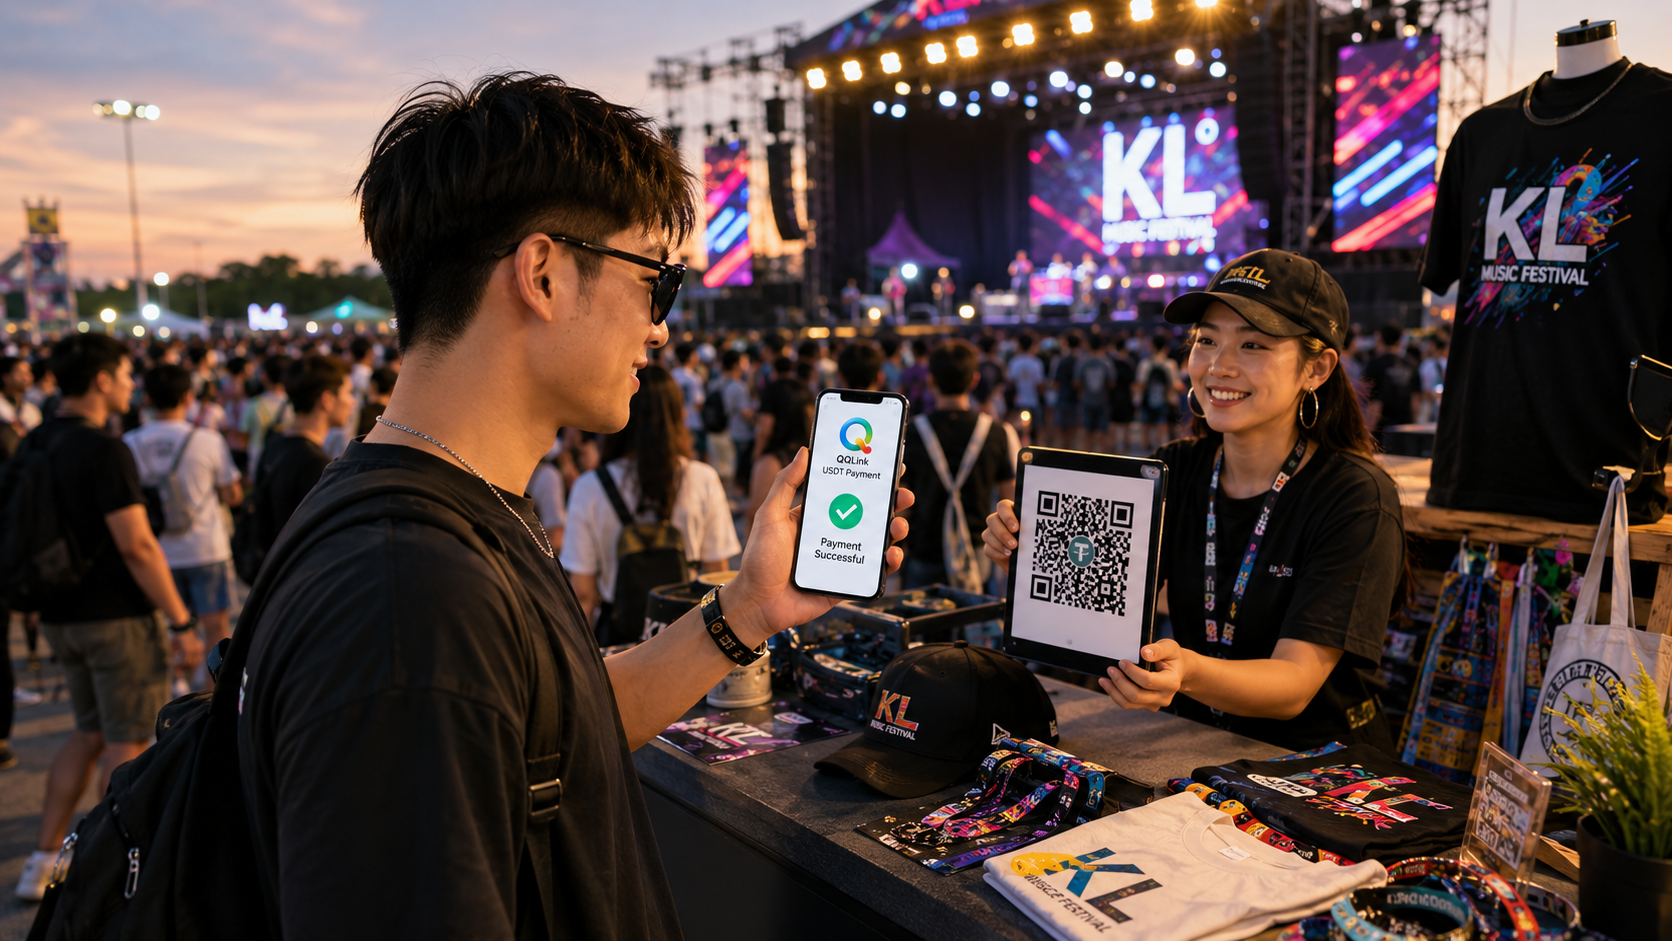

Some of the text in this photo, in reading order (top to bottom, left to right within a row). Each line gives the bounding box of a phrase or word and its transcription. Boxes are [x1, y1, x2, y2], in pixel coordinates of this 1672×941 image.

[1484, 187, 1587, 262] KL
[1481, 265, 1589, 286] MUSIC FESTIVAL
[836, 454, 869, 466] QQLink
[822, 466, 881, 479] USDT Payment
[820, 537, 862, 551] Payment
[814, 549, 865, 564] Successful
[874, 689, 919, 731] KL
[885, 724, 916, 741] FESTIVAL
[1066, 847, 1163, 924] KL
[1058, 896, 1112, 934] FESTIVAL
